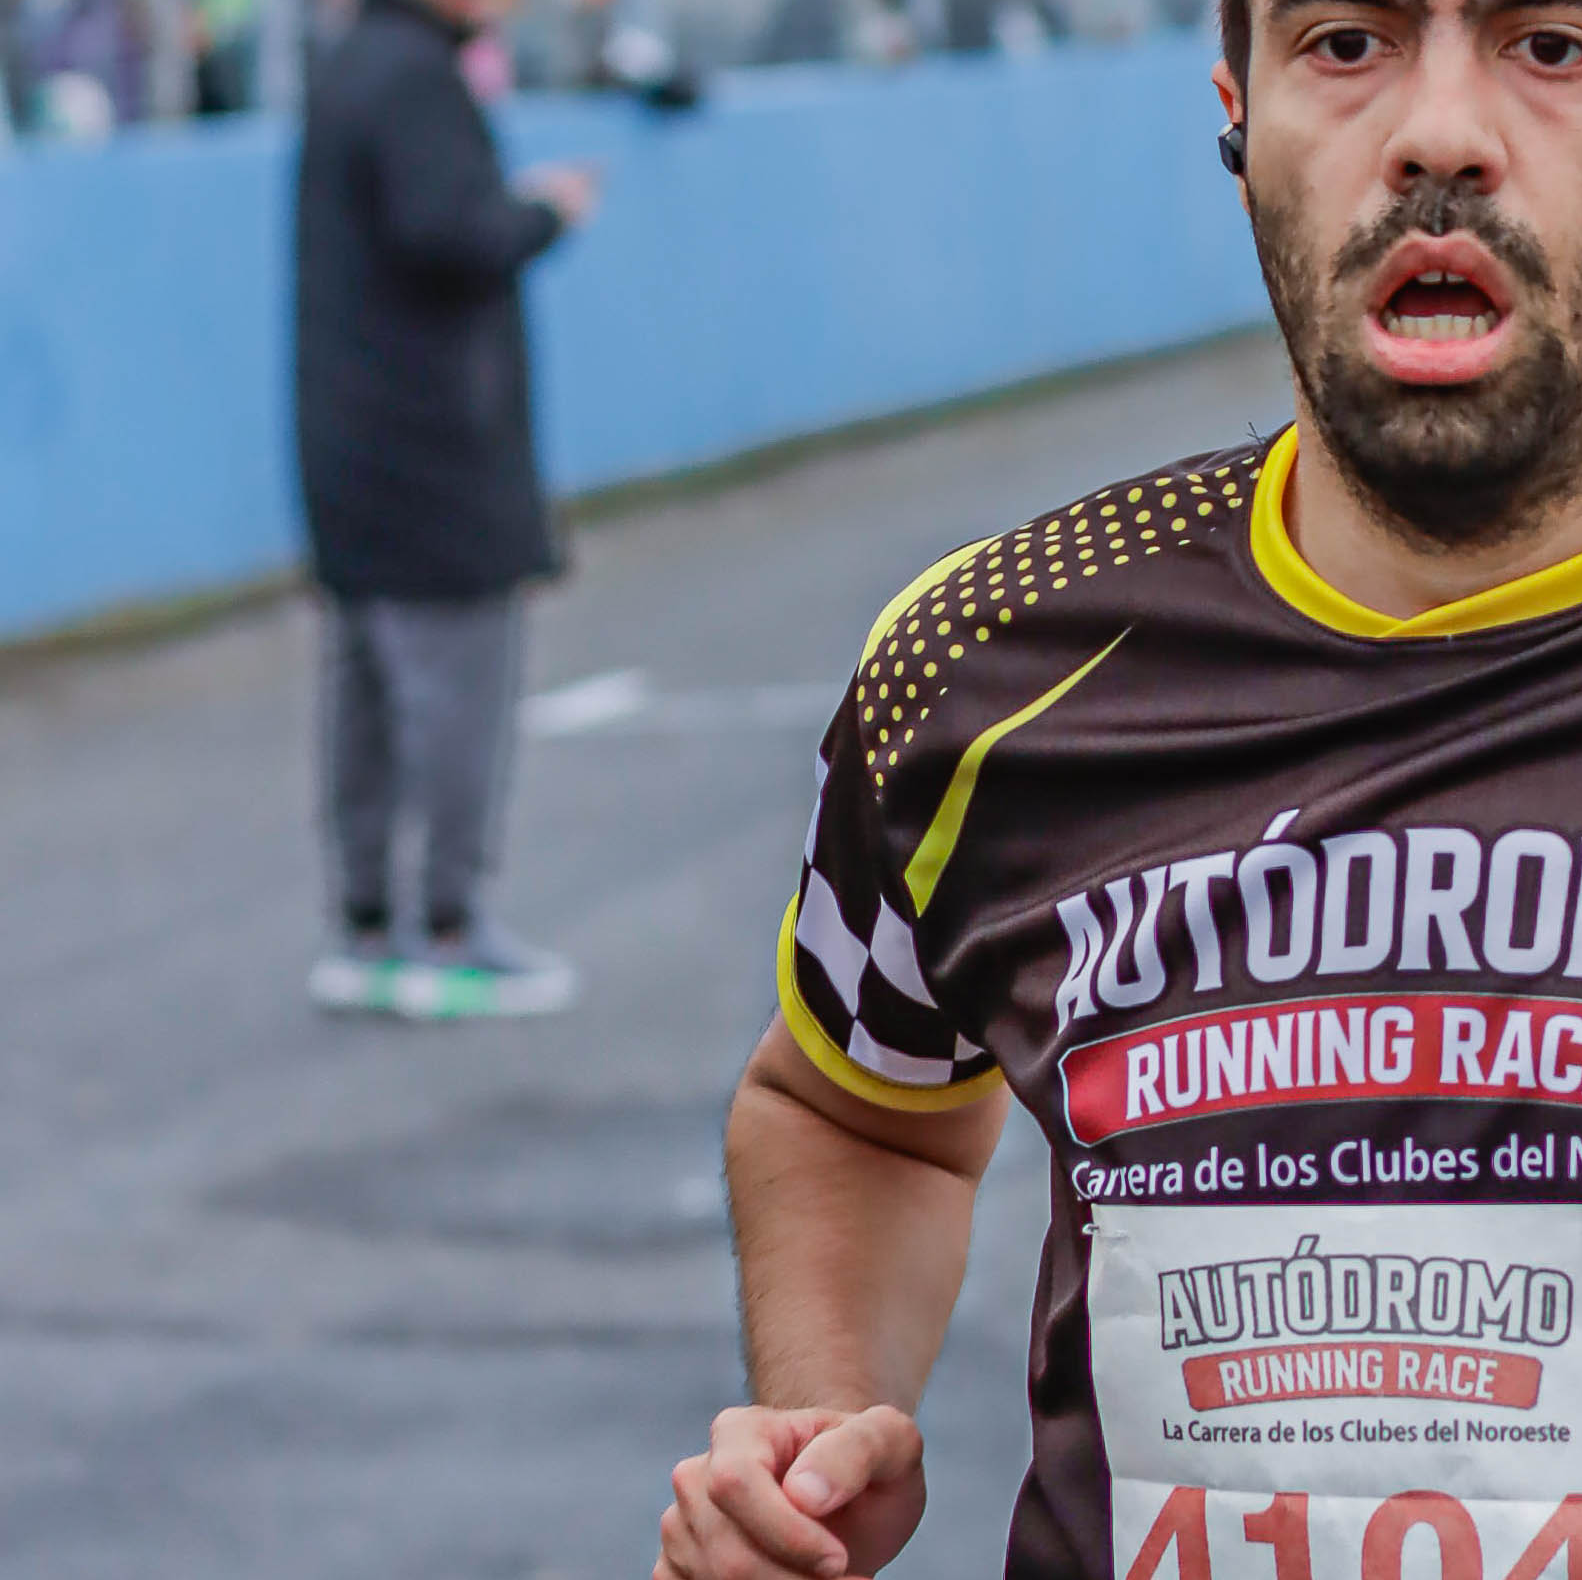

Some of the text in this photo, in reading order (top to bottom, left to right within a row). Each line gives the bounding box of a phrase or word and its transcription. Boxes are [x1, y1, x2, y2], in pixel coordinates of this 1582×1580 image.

[1124, 1009, 1413, 1121] RUNNING
[1071, 1159, 1183, 1202] Carrera
[1194, 1146, 1245, 1192] de
[1257, 1142, 1318, 1188] los
[1330, 1136, 1479, 1184] Clubes
[1492, 1133, 1554, 1179] del
[1158, 1234, 1574, 1349] AUTÓDROMO
[1217, 1349, 1499, 1402] RUNNING RACE
[1162, 1419, 1571, 1443] La Carrera de los Clubes del Noroeste
